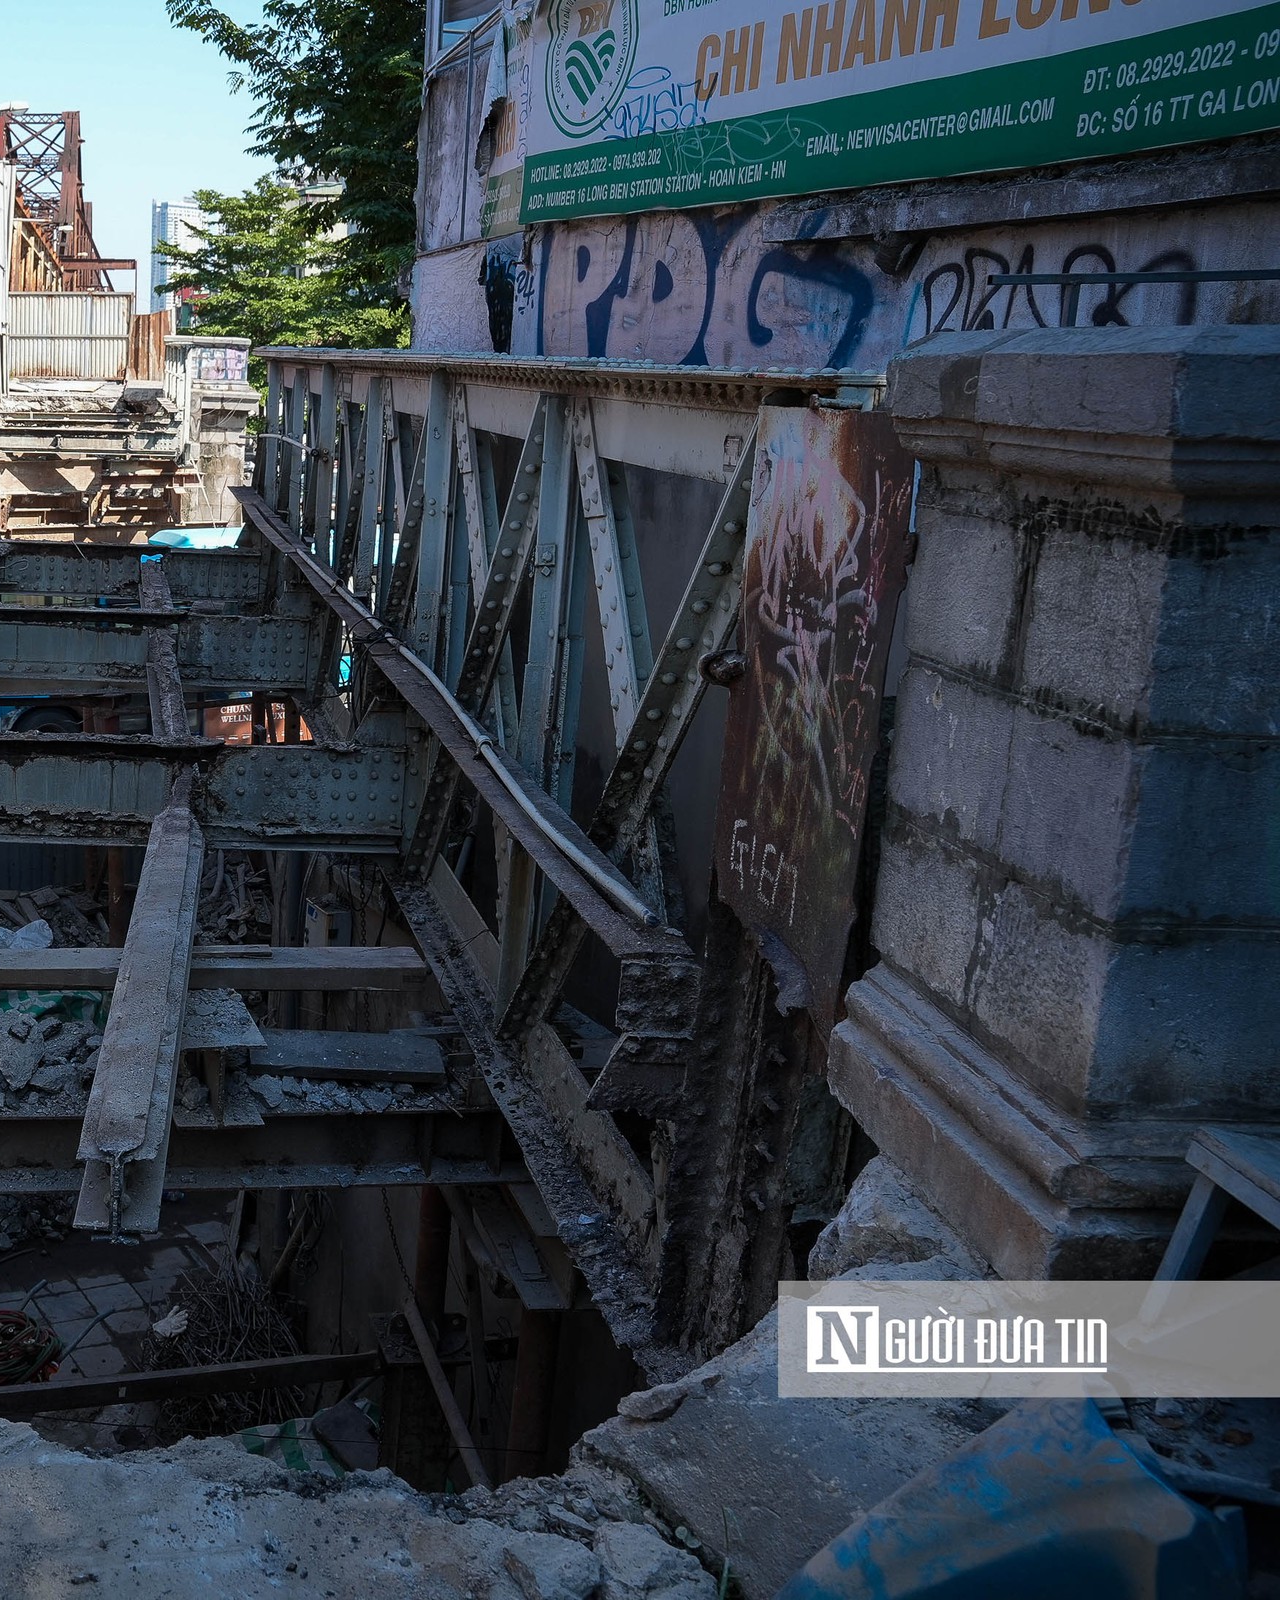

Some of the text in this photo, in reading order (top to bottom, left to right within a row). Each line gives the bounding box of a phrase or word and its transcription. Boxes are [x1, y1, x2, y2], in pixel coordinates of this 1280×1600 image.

[695, 21, 765, 102] CHI
[1083, 66, 1111, 93] ĐT:
[1116, 40, 1236, 89] 08.2929.2022
[806, 133, 843, 157] EMAIL:
[847, 97, 1055, 151] NEWVISACENTER@GMAIL.COM
[1076, 111, 1106, 137] ĐC:
[1111, 94, 1140, 132] SỐ
[1144, 101, 1163, 126] 16
[1170, 94, 1194, 121] TT
[1198, 89, 1226, 117] GA
[528, 195, 545, 210] ADD:
[546, 190, 575, 207] NUMBER
[578, 188, 586, 203] 16
[587, 185, 608, 202] LONG
[610, 183, 629, 199] BIEN
[630, 177, 664, 197] STATION
[665, 172, 702, 192] STATION
[709, 168, 736, 187] HOAN
[738, 163, 763, 184] KIEM
[771, 160, 787, 179] HN
[531, 165, 562, 183] HOTLINE:
[563, 155, 607, 179] 08.2929.2022
[613, 148, 661, 169] 0974.939.202
